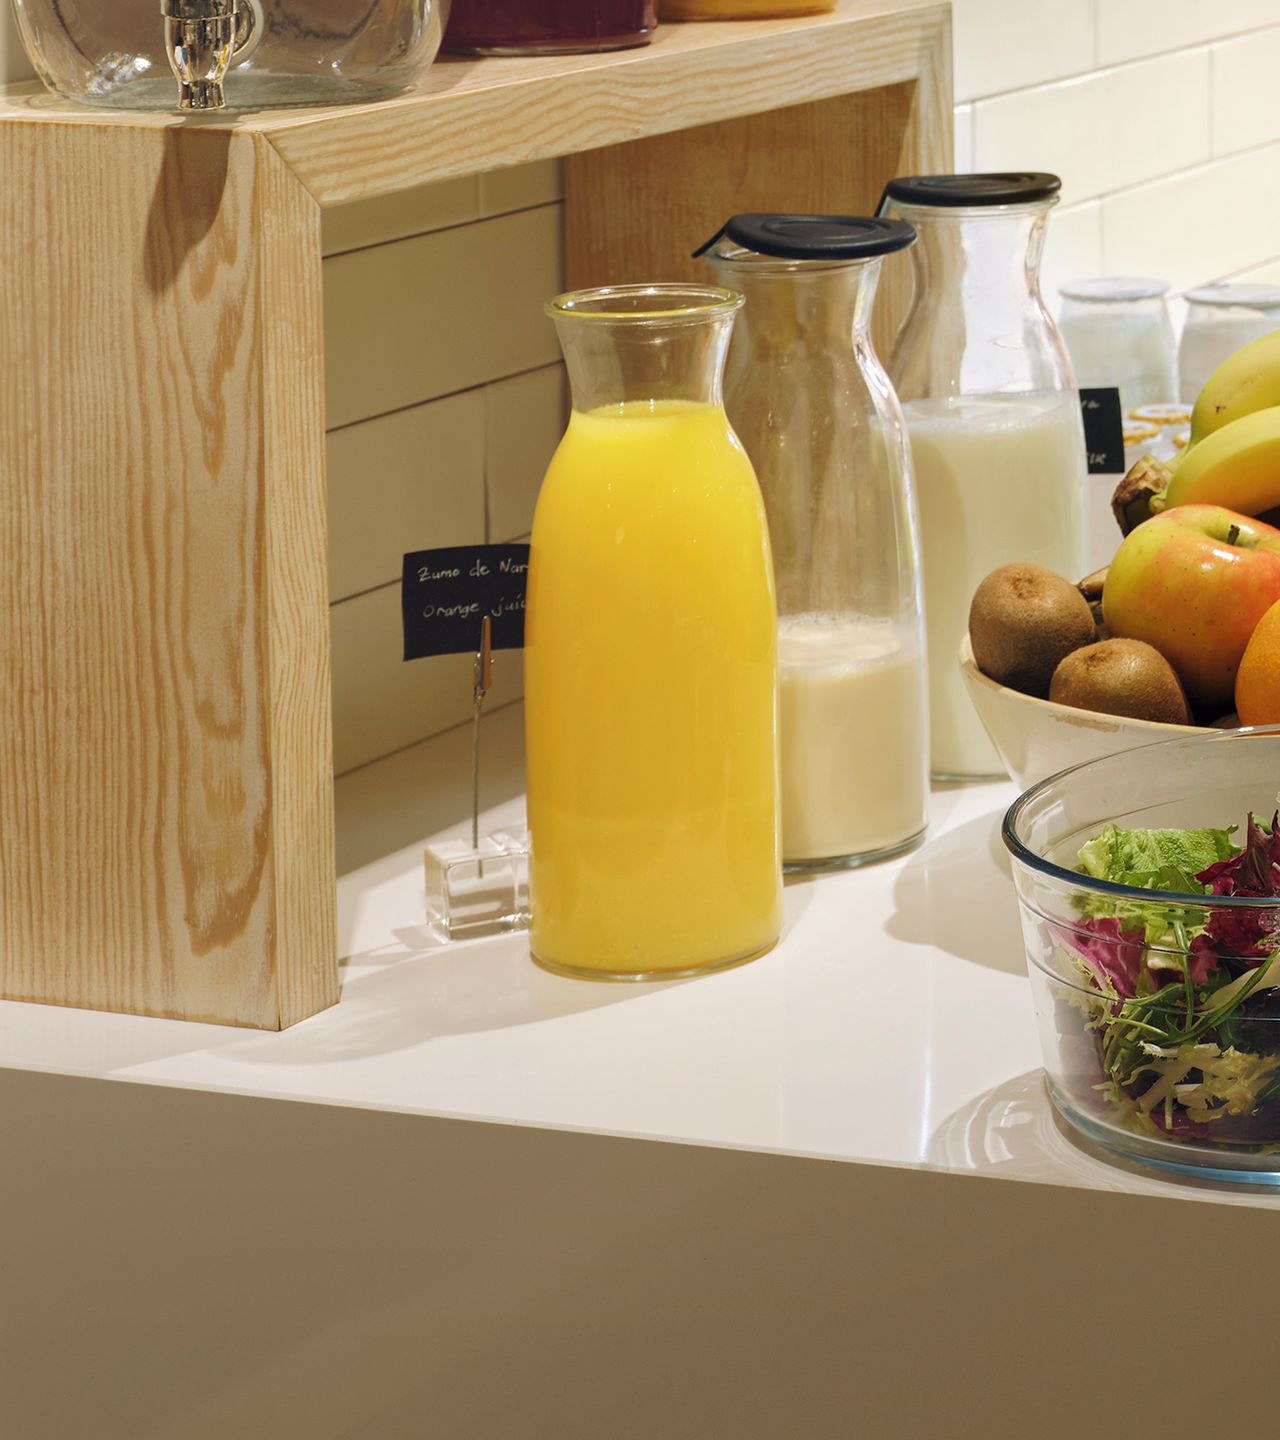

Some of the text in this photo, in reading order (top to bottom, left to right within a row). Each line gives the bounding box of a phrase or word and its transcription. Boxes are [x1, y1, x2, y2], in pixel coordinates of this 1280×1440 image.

[417, 558, 529, 582] Zumo de Nar
[423, 593, 526, 619] Orange juic
